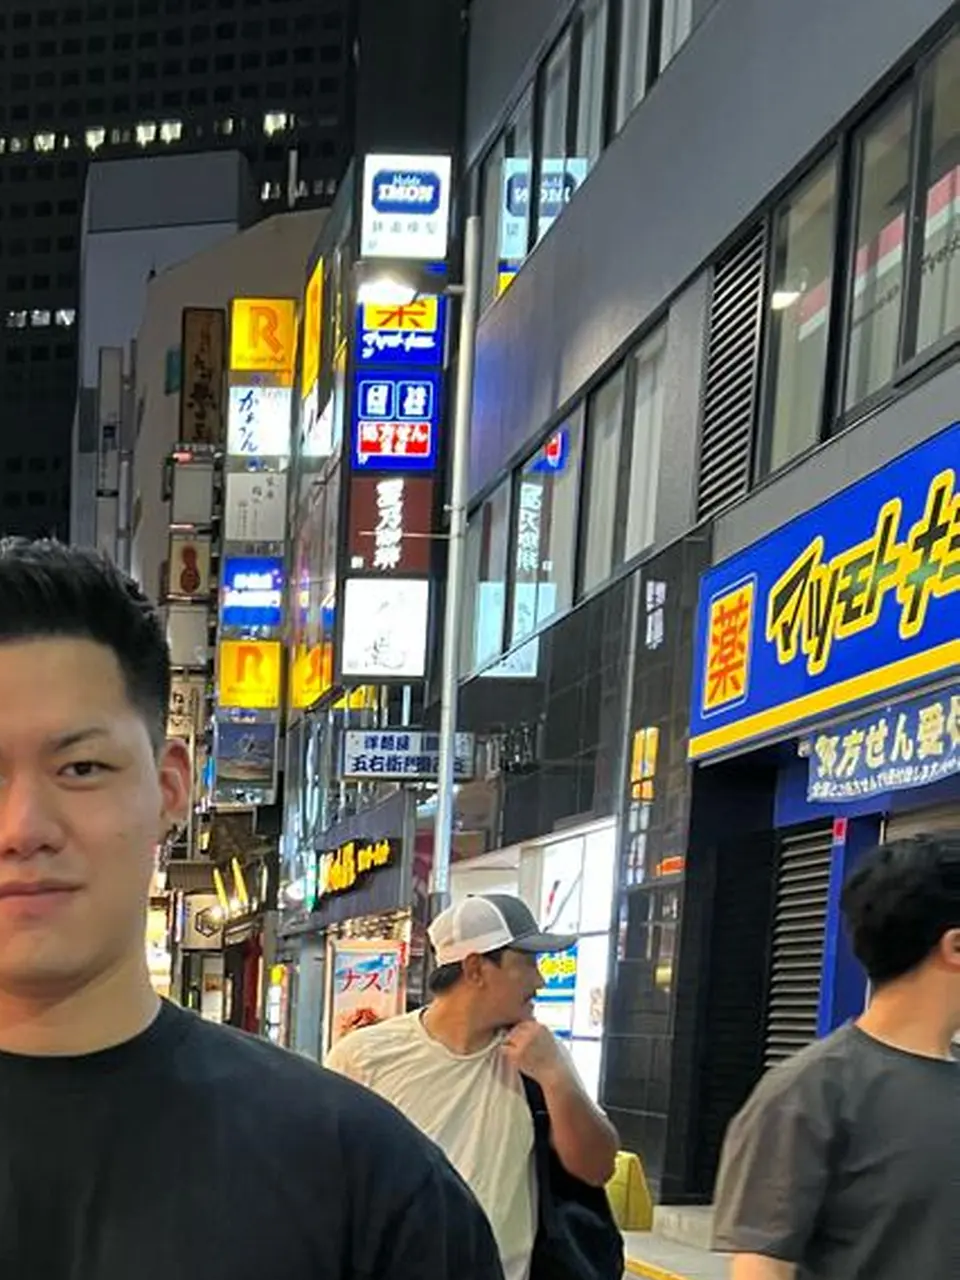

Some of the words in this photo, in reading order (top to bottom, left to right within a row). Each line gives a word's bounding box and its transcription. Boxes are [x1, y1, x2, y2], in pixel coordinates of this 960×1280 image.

[707, 592, 749, 702] 薬
[768, 469, 960, 675] マツモトキ
